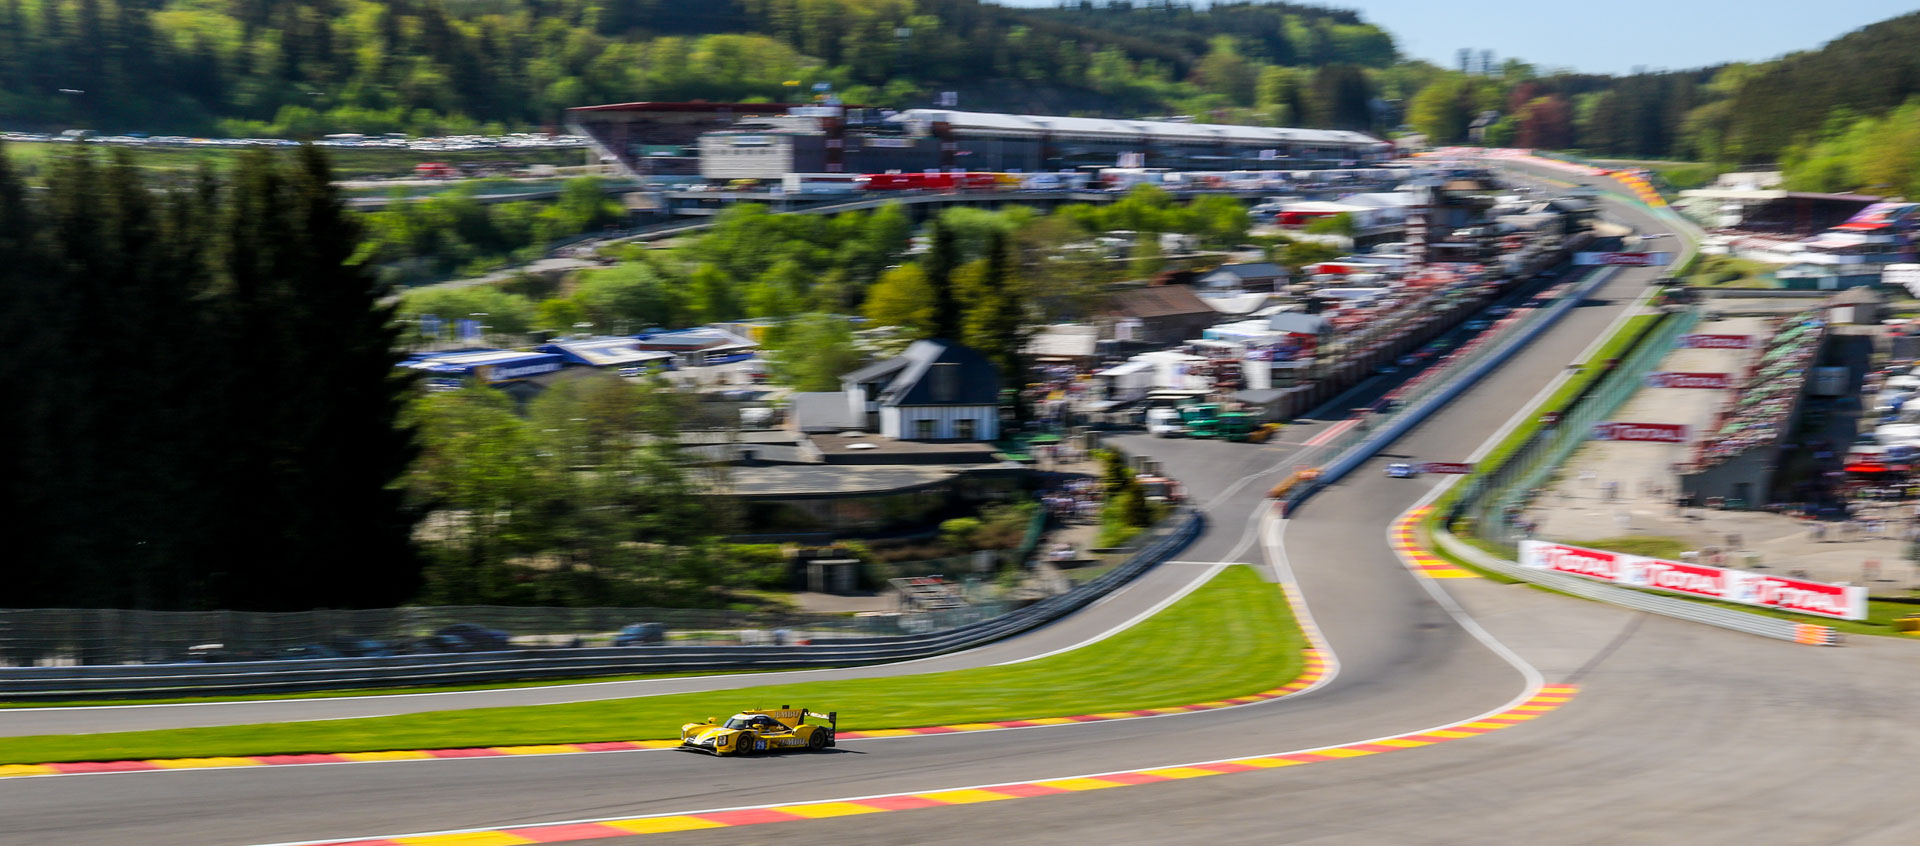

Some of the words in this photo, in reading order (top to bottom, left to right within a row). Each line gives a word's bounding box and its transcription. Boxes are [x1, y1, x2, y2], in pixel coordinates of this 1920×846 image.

[1612, 425, 1688, 440] TOTAL
[1550, 548, 1621, 577] TOTAL
[1652, 563, 1728, 593] TOTAL
[1763, 579, 1850, 612] TOTAL
[775, 710, 799, 718] JUMBO
[756, 741, 765, 750] 29
